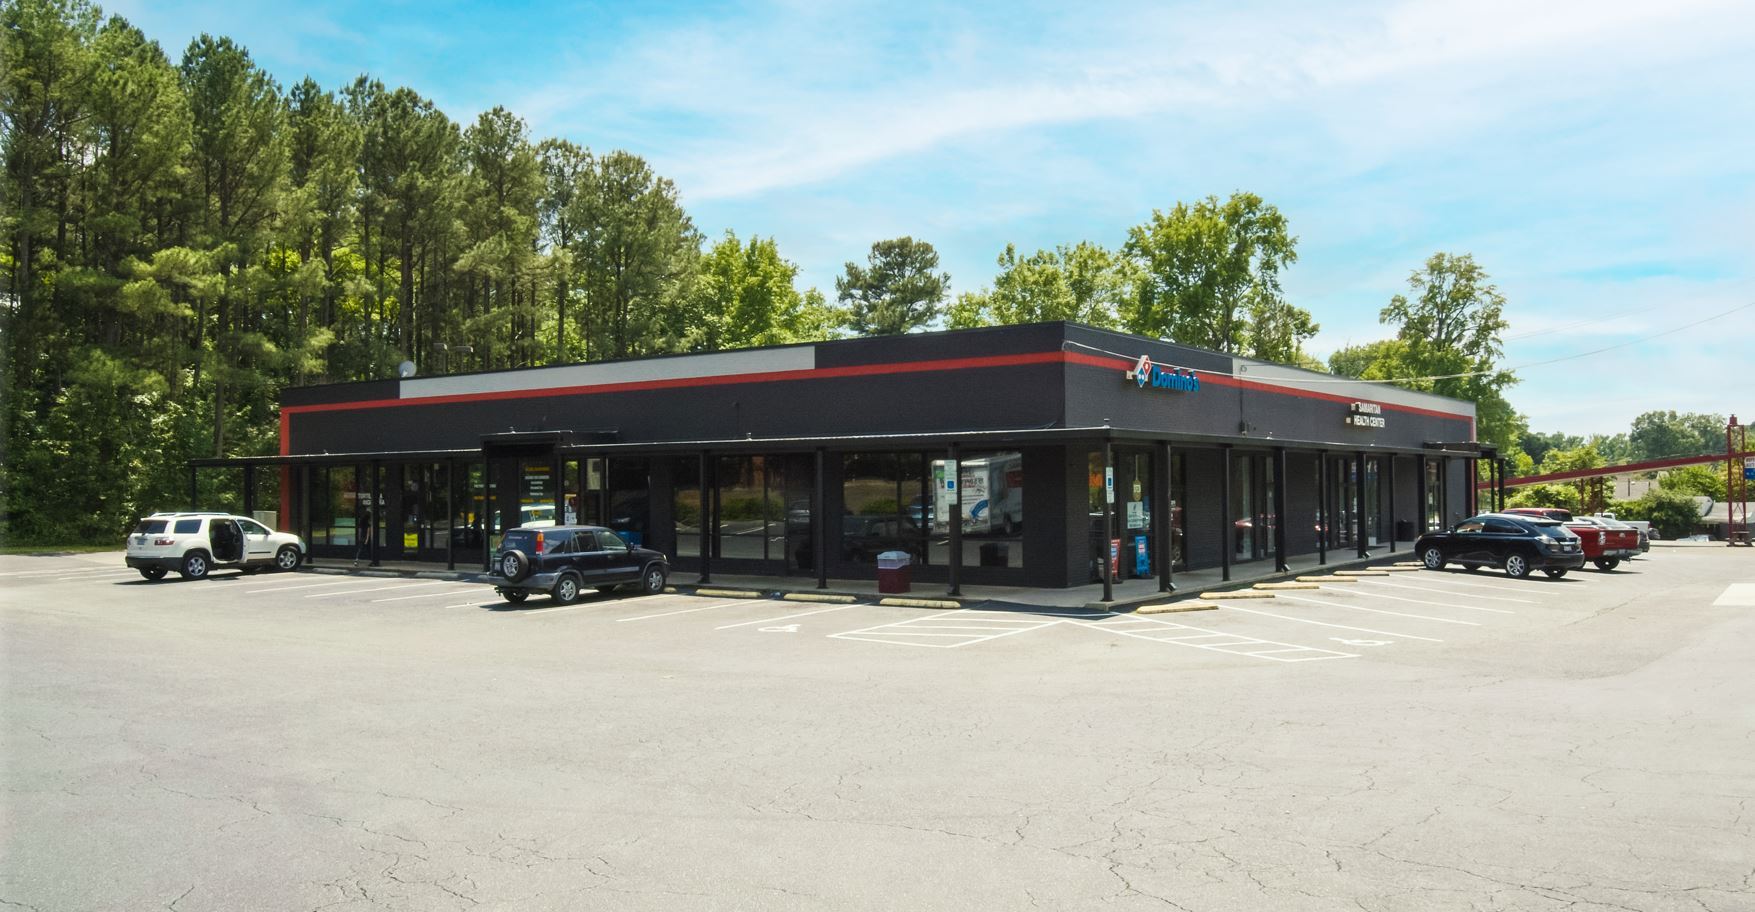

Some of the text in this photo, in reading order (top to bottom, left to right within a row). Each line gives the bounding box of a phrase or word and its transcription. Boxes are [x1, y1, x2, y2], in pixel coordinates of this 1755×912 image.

[1151, 364, 1200, 392] Domino's
[1354, 414, 1385, 427] HEALTH CENTER
